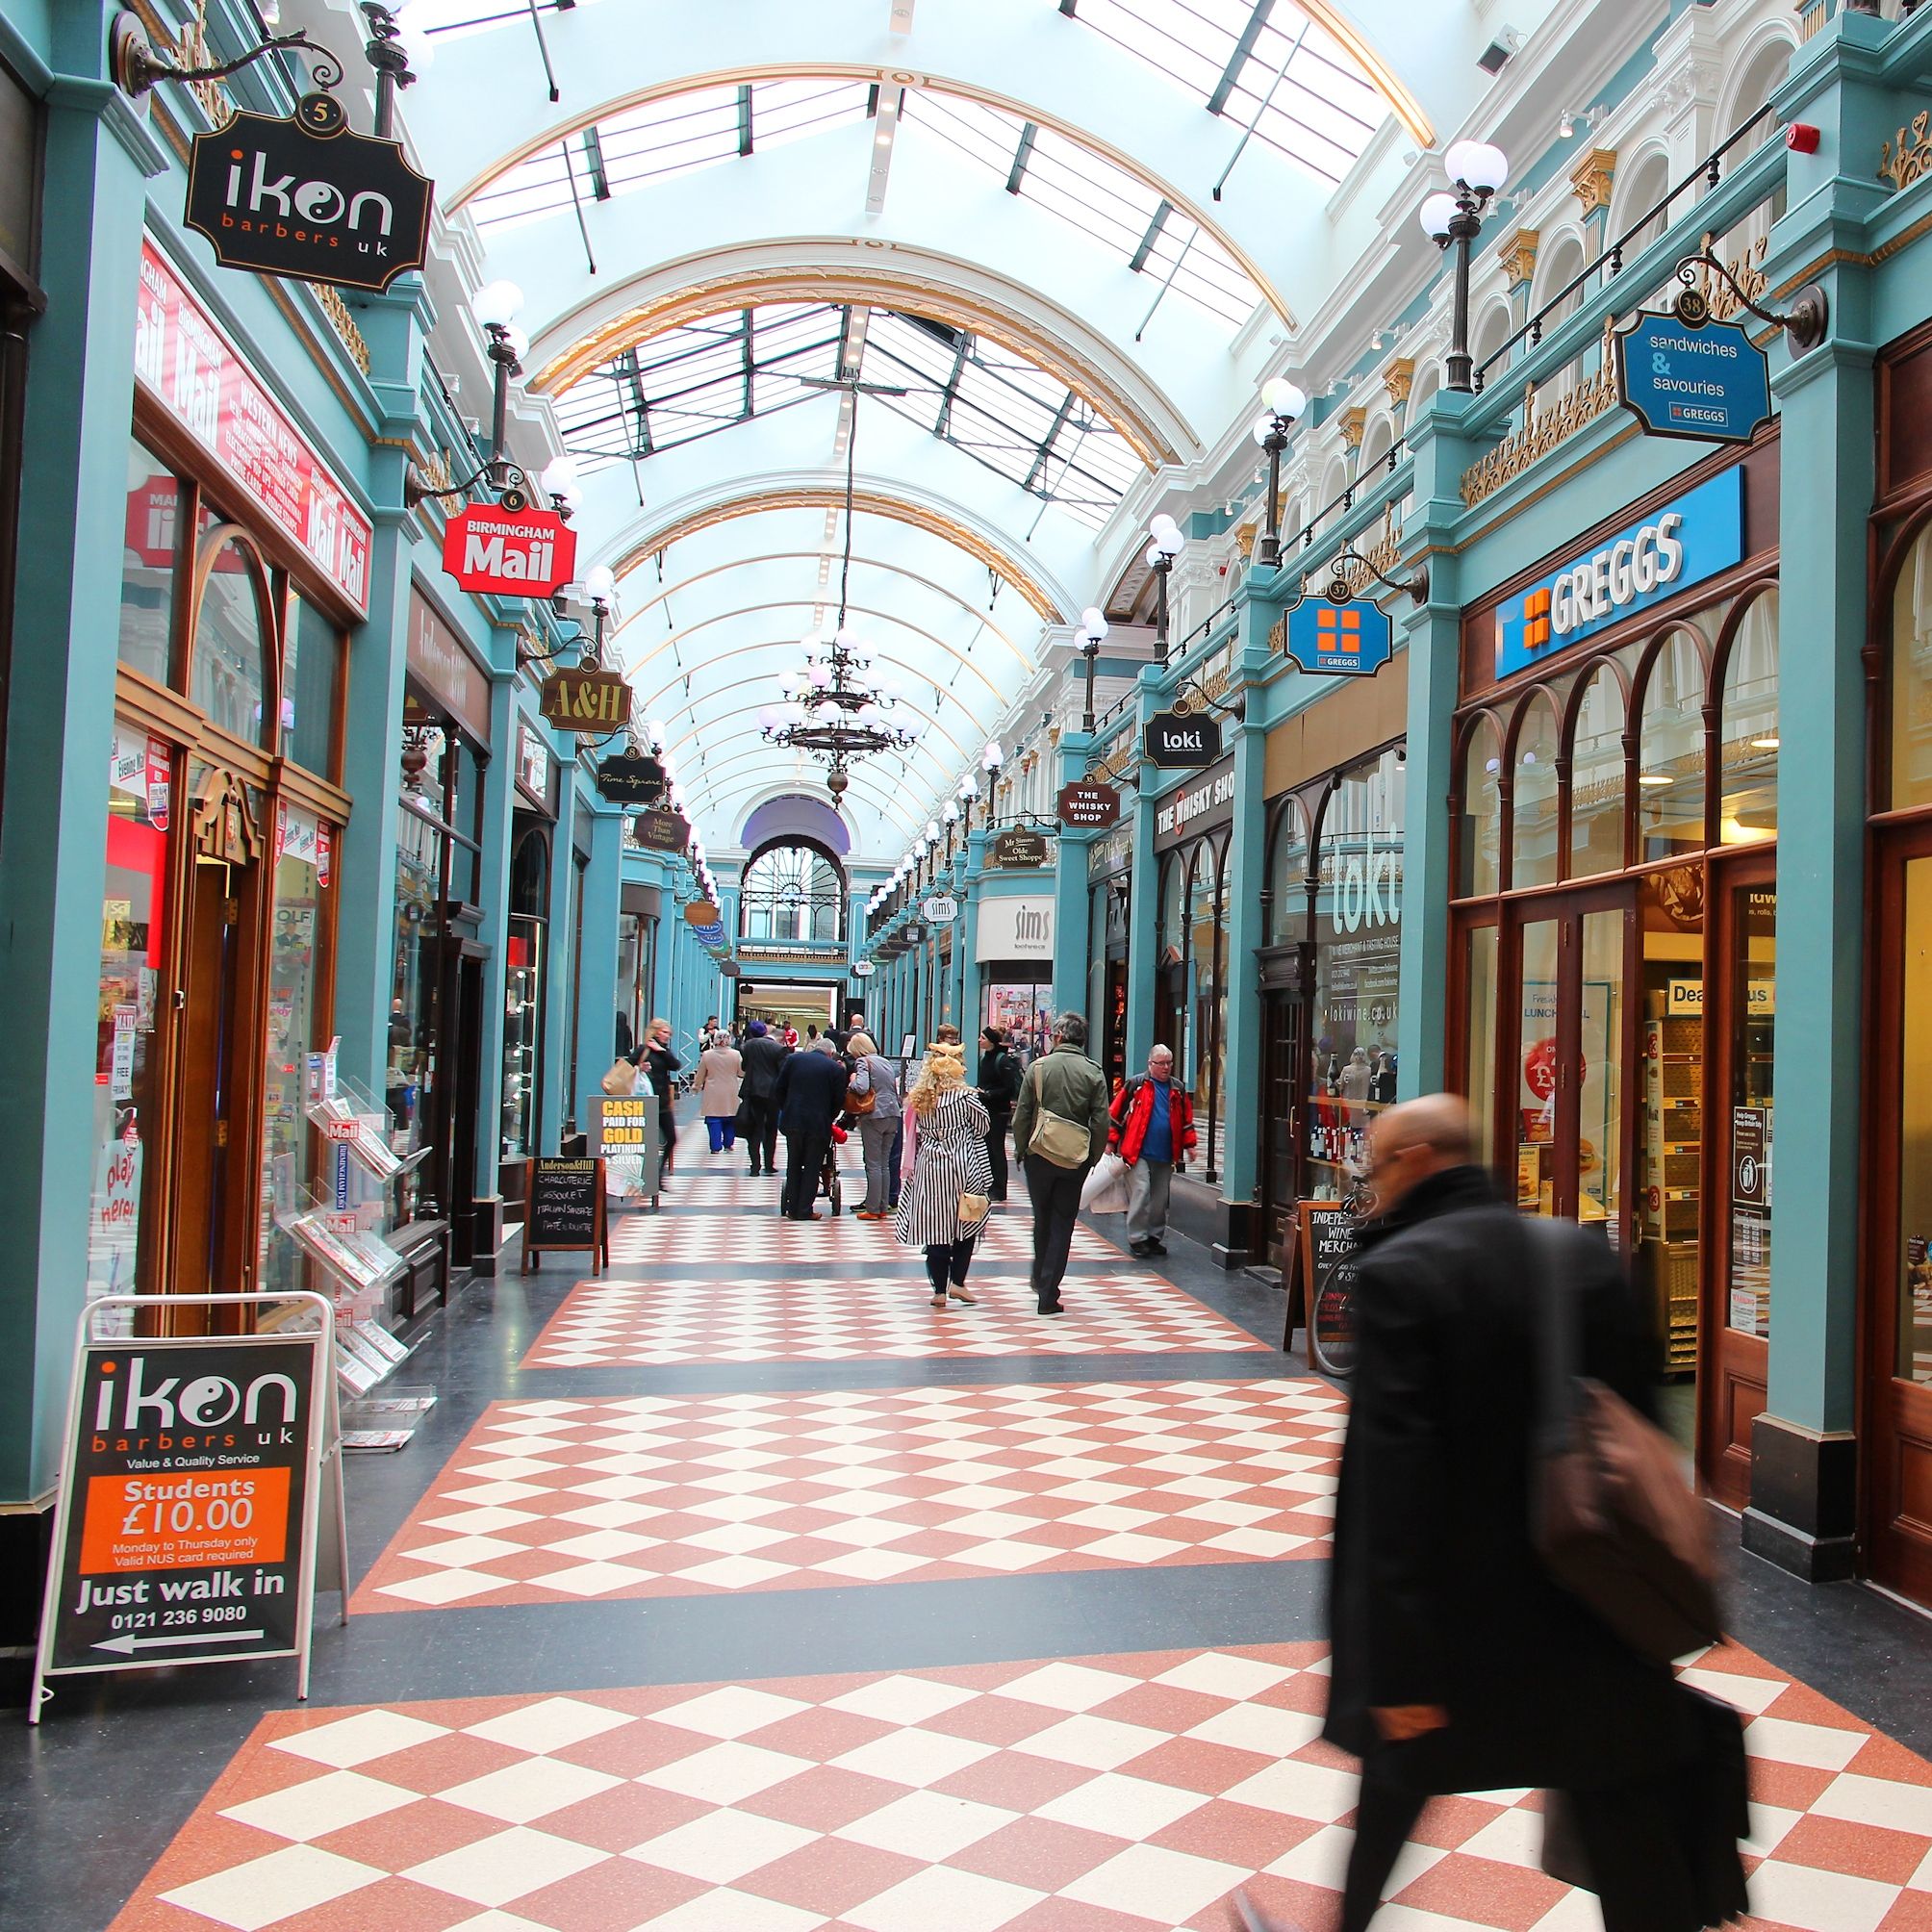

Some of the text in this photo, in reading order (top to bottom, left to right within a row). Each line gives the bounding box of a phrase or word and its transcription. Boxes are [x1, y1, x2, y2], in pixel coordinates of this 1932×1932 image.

[313, 101, 329, 122] 5
[226, 148, 394, 237] ikon
[220, 212, 389, 257] barbers uk
[1683, 296, 1702, 314] 38
[178, 301, 222, 371] BIRMINGHAM
[1649, 336, 1738, 359] sandwiches
[1651, 352, 1671, 375] &
[173, 328, 221, 450] Mail
[1652, 377, 1725, 397] savouries
[1683, 407, 1725, 423] GREGGS
[241, 380, 299, 469] WESTERN NEWS
[509, 495, 518, 506] 6
[307, 487, 337, 575] Mail
[467, 520, 555, 541] BIRMINGHAM
[339, 525, 366, 606] Mail
[462, 534, 554, 582] Mail
[1551, 512, 1683, 635] GREGGS
[1333, 584, 1346, 595] 37
[1327, 657, 1358, 667] GREGGS
[549, 679, 623, 722] A&H
[1162, 730, 1203, 749] loki
[628, 747, 637, 757] 8
[599, 773, 662, 790] Time Square
[1077, 791, 1099, 800] THE
[1157, 771, 1234, 835] THE WHISKY SHO
[1068, 801, 1111, 812] WHISKY
[653, 818, 674, 828] More
[1073, 813, 1102, 822] SHOP
[648, 831, 674, 844] Vintage
[653, 826, 671, 835] Than
[1004, 838, 1015, 849] Mr
[1332, 821, 1400, 936] loki
[931, 900, 951, 915] sims
[1015, 904, 1050, 941] sims
[1384, 934, 1399, 949] HOUSE
[1330, 1001, 1397, 1022] lokiwine.co.uk
[601, 1101, 645, 1117] CASH
[602, 1116, 647, 1128] PAID FOR
[329, 1124, 359, 1139] Mail
[602, 1127, 644, 1144] GOLD
[600, 1143, 646, 1155] PLATINUM
[338, 1144, 347, 1189] BIRMINGHAM
[538, 1159, 595, 1171] Anderson&Hill
[612, 1156, 643, 1165] SILVER
[107, 1154, 135, 1197] play
[325, 1217, 356, 1233] Mail
[1311, 1211, 1348, 1225] INDEPE
[1328, 1227, 1355, 1240] WINE
[94, 1357, 297, 1432] ikon
[91, 1427, 293, 1453] barbers uk
[126, 1453, 260, 1469] Value & Quality Service
[123, 1478, 256, 1503] Students
[121, 1497, 254, 1536] £10.00
[112, 1537, 259, 1555] Monday to Thursday only
[114, 1549, 254, 1567] Valid NUS card required
[75, 1568, 285, 1615] Just walk in
[111, 1605, 247, 1631] 0121 236 9080
